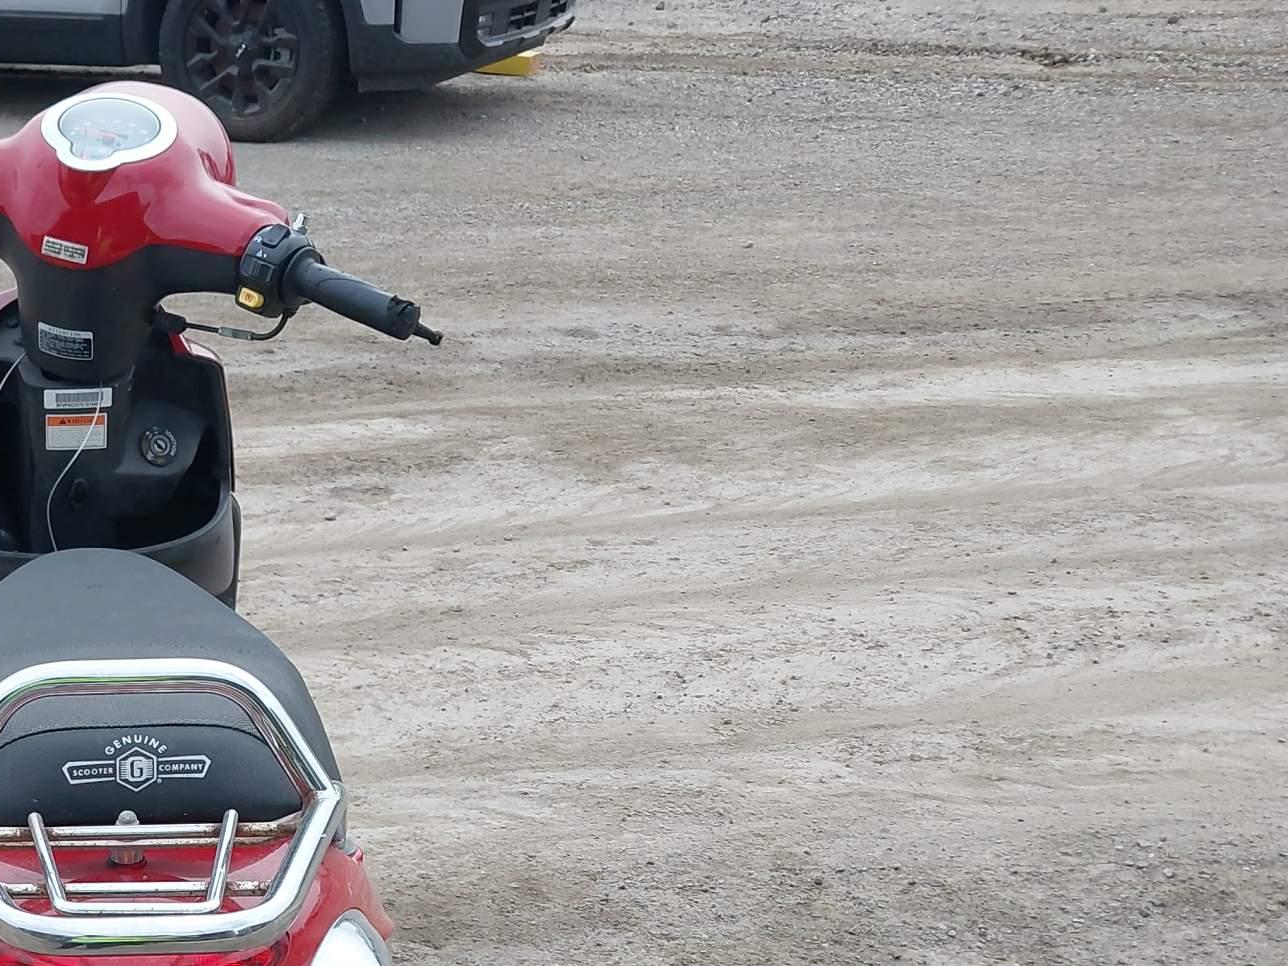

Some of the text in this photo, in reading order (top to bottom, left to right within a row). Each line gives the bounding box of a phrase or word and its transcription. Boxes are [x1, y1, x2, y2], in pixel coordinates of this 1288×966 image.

[105, 734, 168, 756] GENUINE
[72, 763, 205, 777] SCOOTER COMPANY
[128, 757, 147, 781] G
